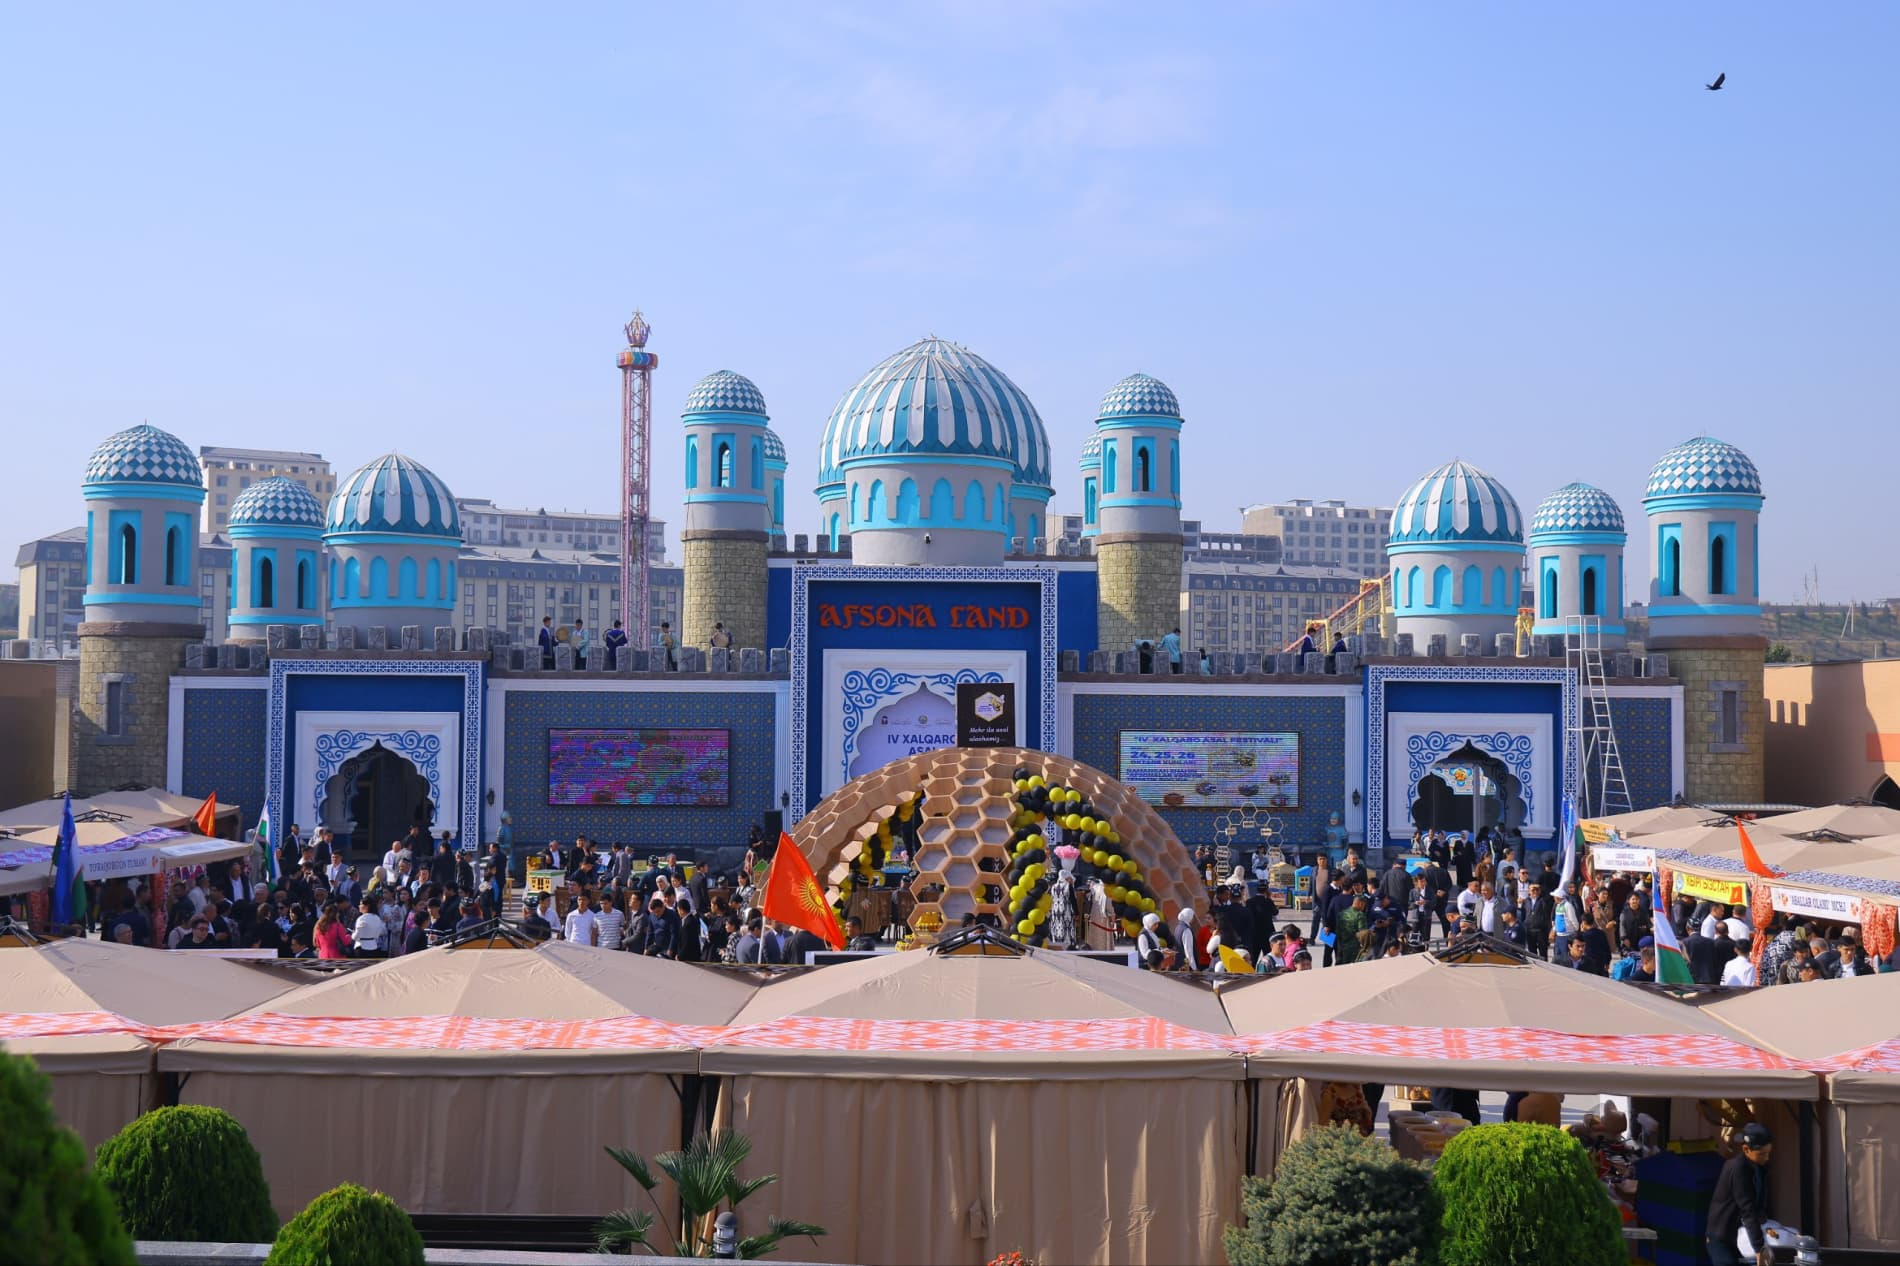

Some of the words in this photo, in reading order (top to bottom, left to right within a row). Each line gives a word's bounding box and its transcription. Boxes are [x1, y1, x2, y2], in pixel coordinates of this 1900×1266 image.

[819, 604, 936, 629] AFSONA
[950, 606, 1029, 628] LAND
[888, 734, 899, 744] IV
